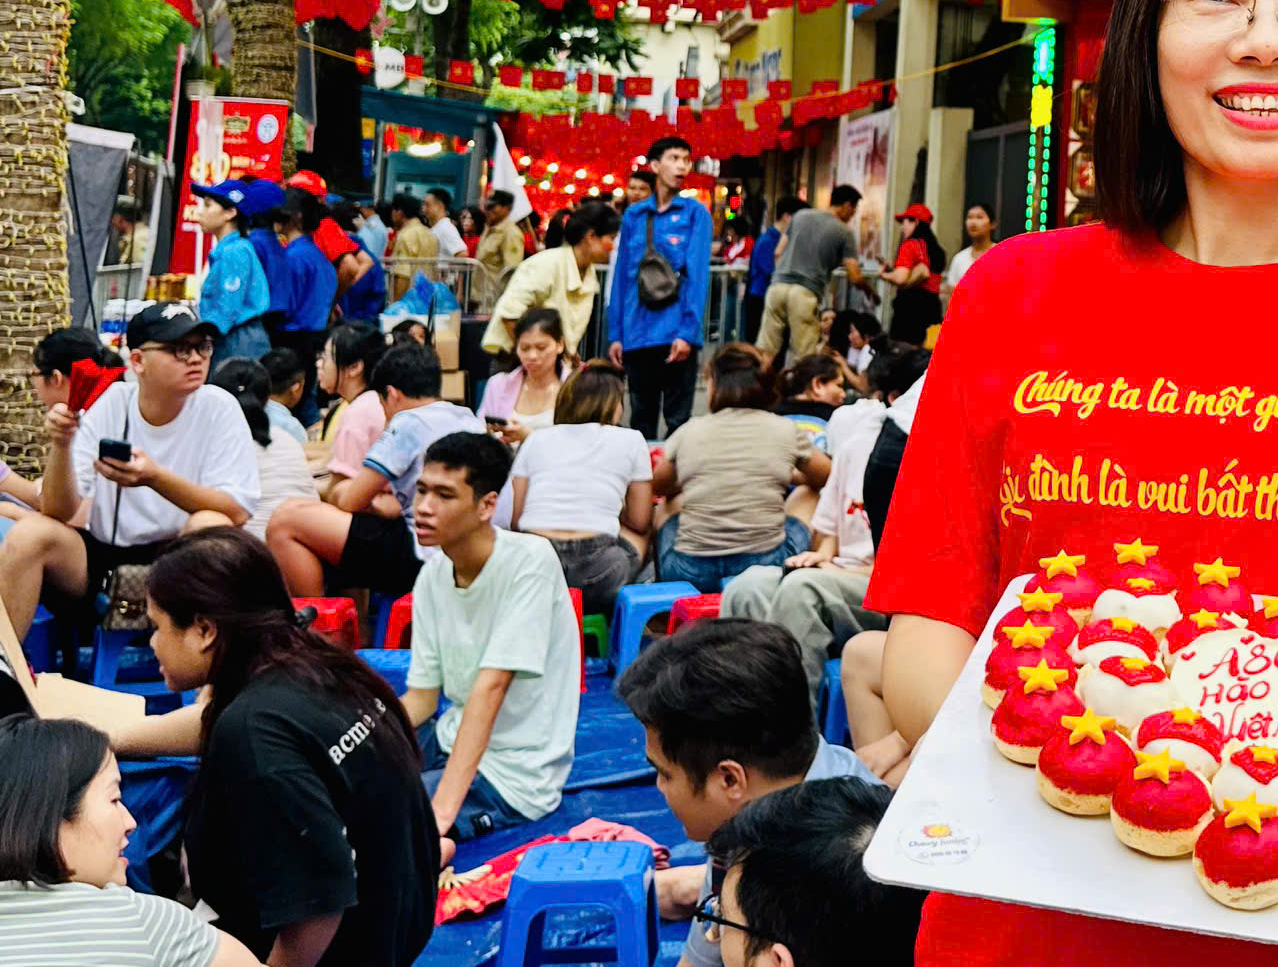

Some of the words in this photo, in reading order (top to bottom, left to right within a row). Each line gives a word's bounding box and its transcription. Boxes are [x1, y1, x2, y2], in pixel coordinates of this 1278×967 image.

[1013, 370, 1104, 419] Chúng
[1107, 377, 1143, 410] ta
[1146, 377, 1181, 415] là
[1184, 385, 1254, 424] một
[1028, 453, 1091, 504] đình
[1099, 458, 1131, 508] là
[1138, 474, 1190, 514] vui
[1197, 458, 1250, 518] bất
